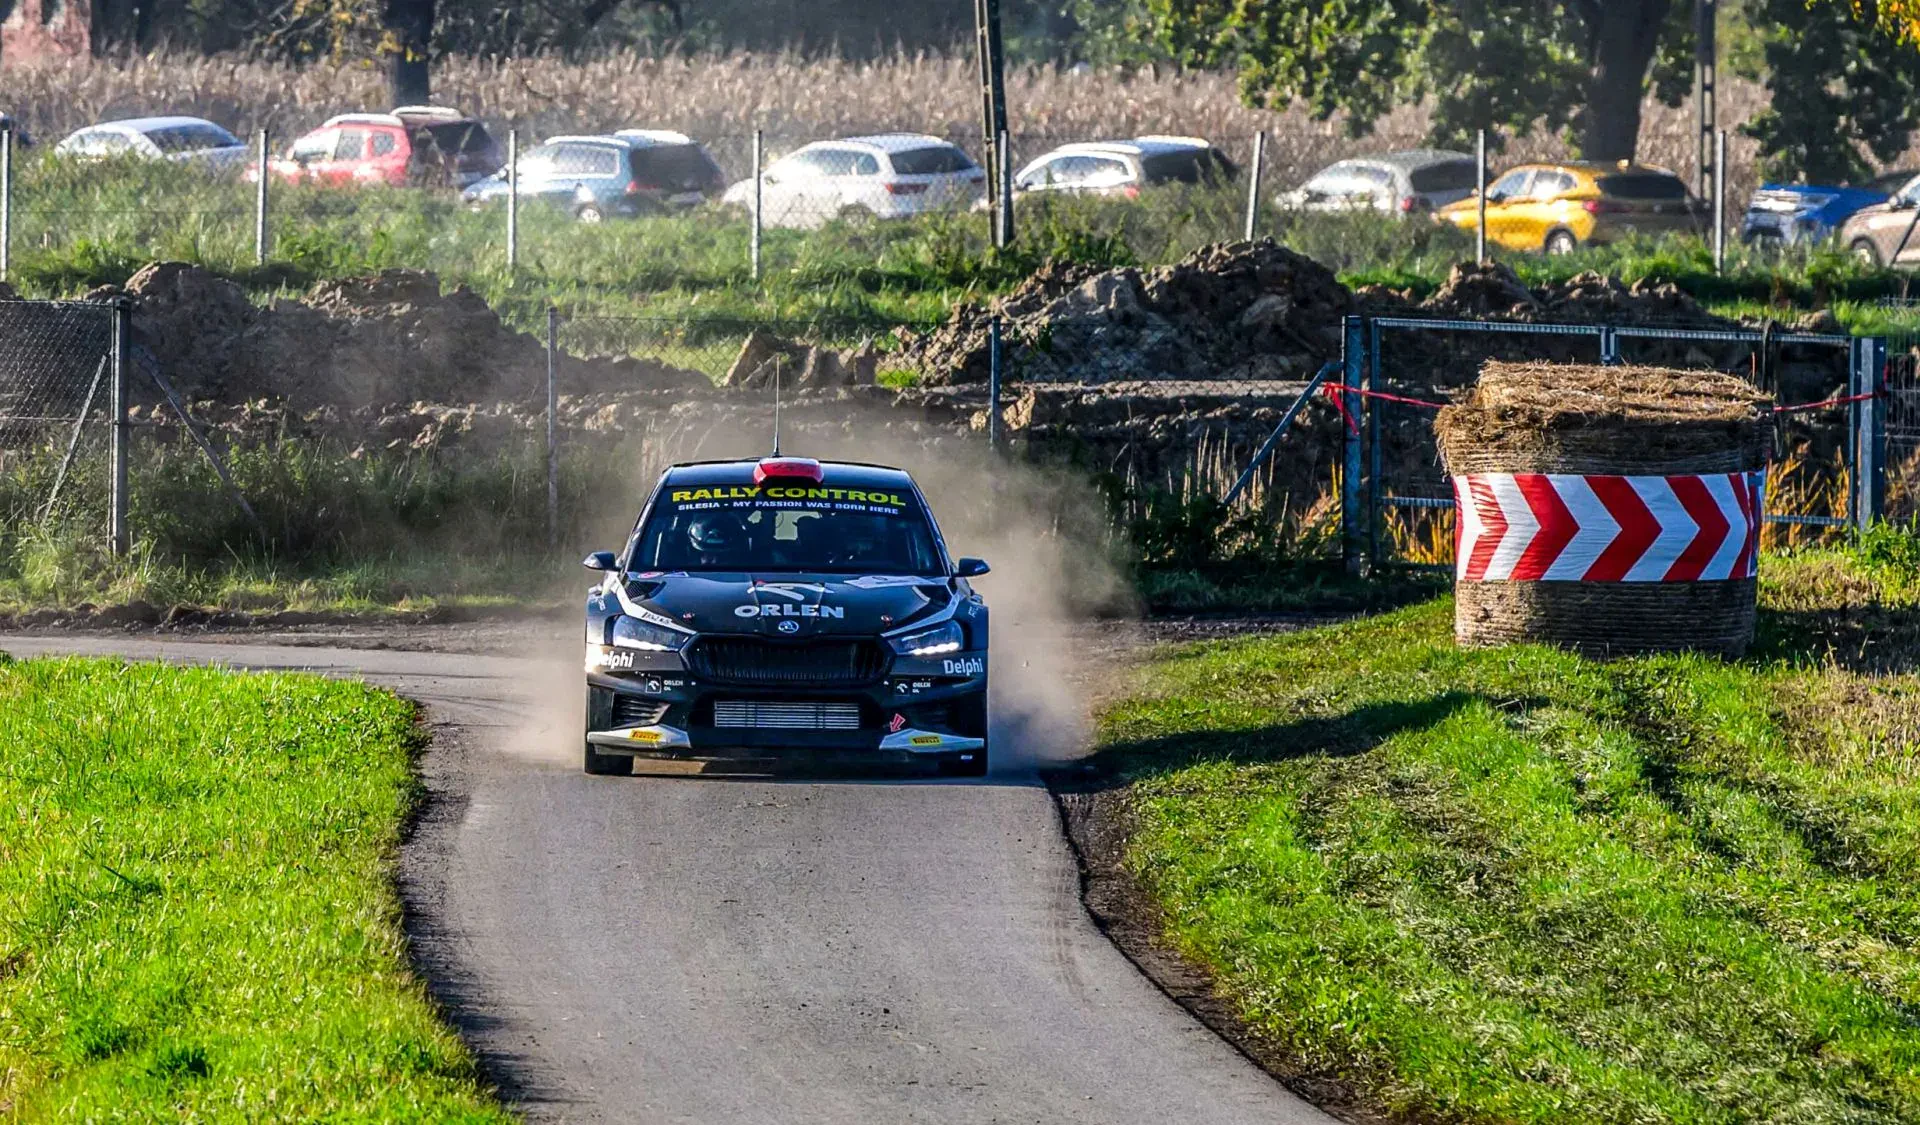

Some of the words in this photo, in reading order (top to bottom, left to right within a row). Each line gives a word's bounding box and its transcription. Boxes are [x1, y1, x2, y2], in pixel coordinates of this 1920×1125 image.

[672, 487, 761, 502] RALLY
[767, 488, 906, 506] CONTROL
[678, 502, 720, 511] SILESIA
[835, 503, 866, 511] BORN
[869, 505, 899, 514] HERE
[734, 604, 844, 618] ORLEN
[594, 651, 634, 669] elphi
[943, 658, 984, 676] Delphi
